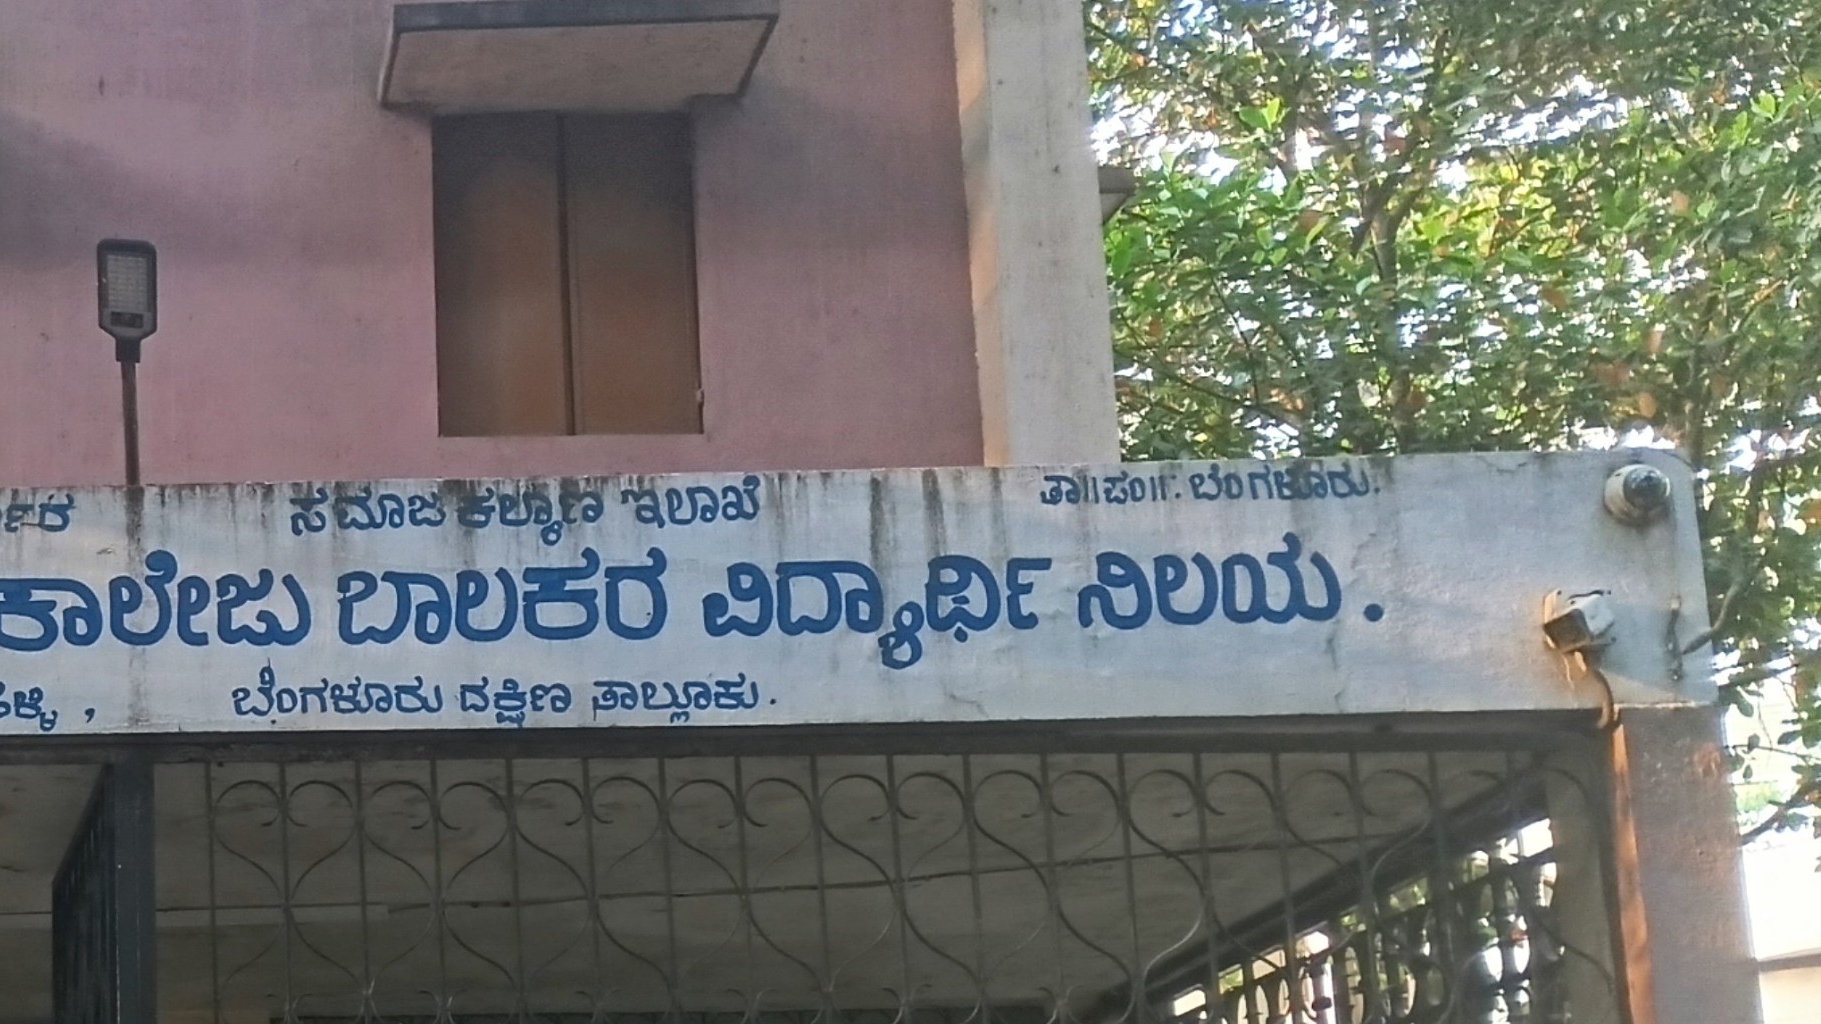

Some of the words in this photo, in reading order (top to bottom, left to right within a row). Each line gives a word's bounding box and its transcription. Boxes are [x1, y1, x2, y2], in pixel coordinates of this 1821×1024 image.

[290, 487, 446, 536] ಸಮಾಜ
[458, 487, 604, 546] ಕಲ್ಯಾಣ
[621, 475, 760, 528] ಇಲಾಖೆ
[337, 546, 667, 645] ಬಾಲಕರ
[702, 555, 1053, 670] ವಿದ್ಯಾರ್ಥಿ
[232, 665, 443, 716] ಬೆಂಗಳೂರು
[460, 676, 572, 727] ದಕ್ಷಿಣ
